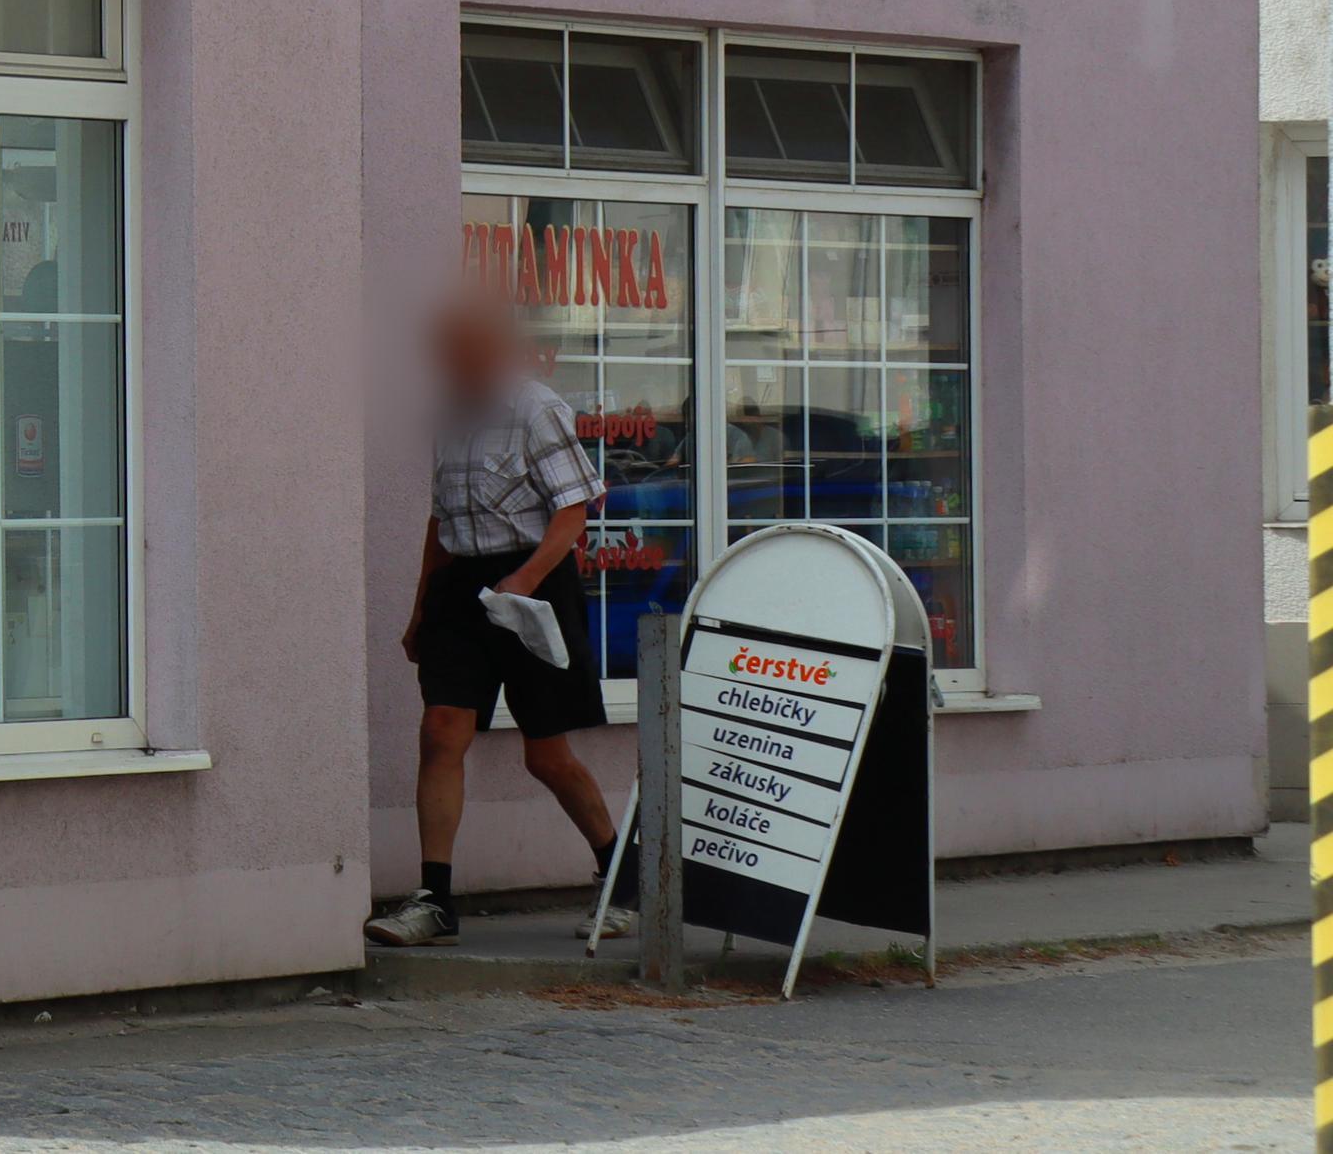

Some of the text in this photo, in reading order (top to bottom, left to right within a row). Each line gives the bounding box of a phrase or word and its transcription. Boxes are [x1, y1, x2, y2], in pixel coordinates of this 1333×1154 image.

[732, 647, 829, 686] čerstvé
[717, 686, 817, 726] chlebíčky
[712, 726, 794, 761] uzenina
[708, 759, 791, 801] zákusky
[704, 799, 771, 834] koláče
[690, 838, 759, 868] pečivo
